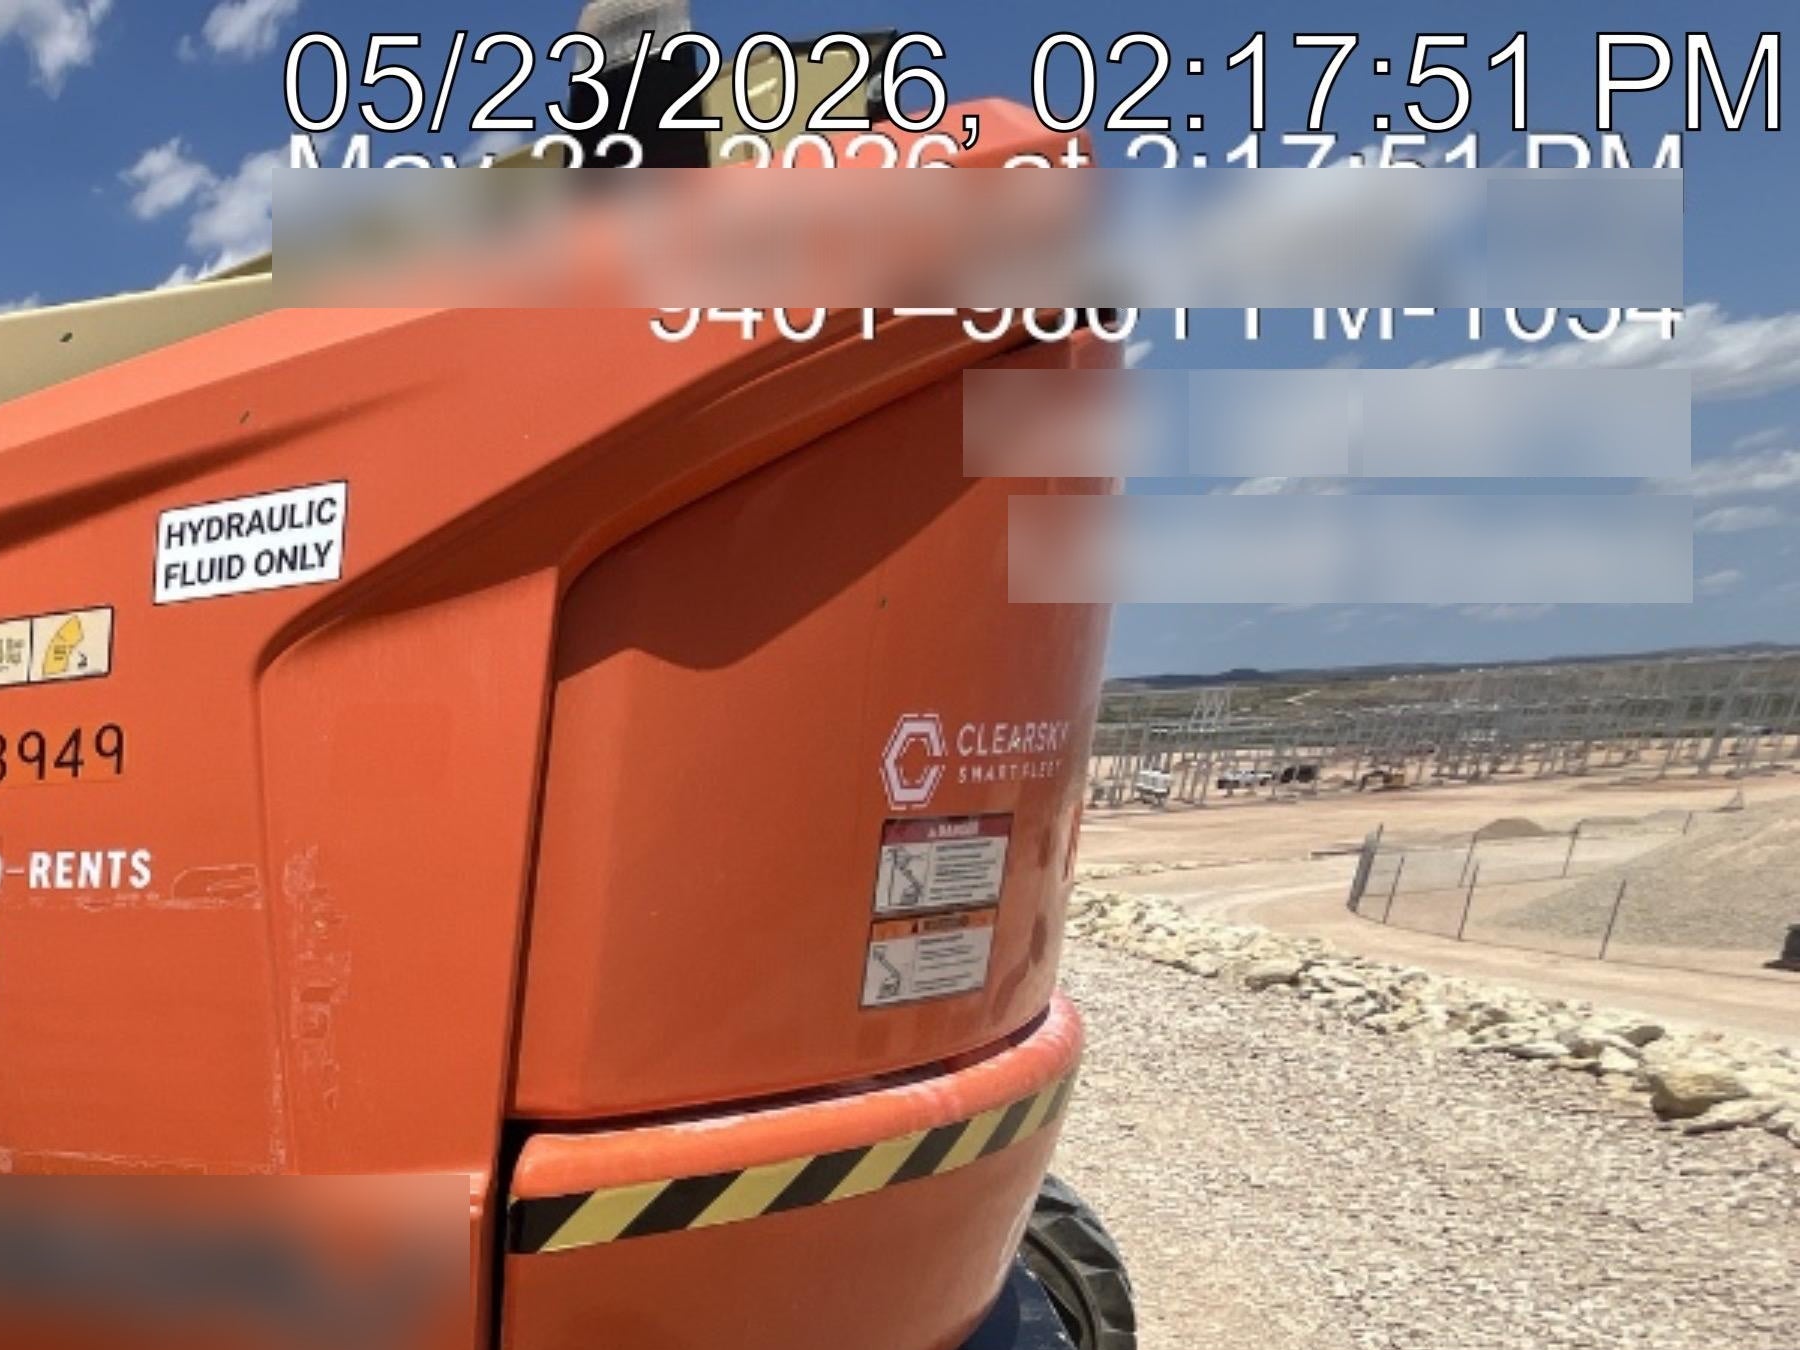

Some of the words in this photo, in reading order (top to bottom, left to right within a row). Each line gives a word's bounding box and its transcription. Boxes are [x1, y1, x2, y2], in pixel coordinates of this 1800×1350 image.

[165, 497, 337, 550] HYDRAULIC
[163, 553, 244, 590] FLUID
[253, 539, 335, 578] ONLY
